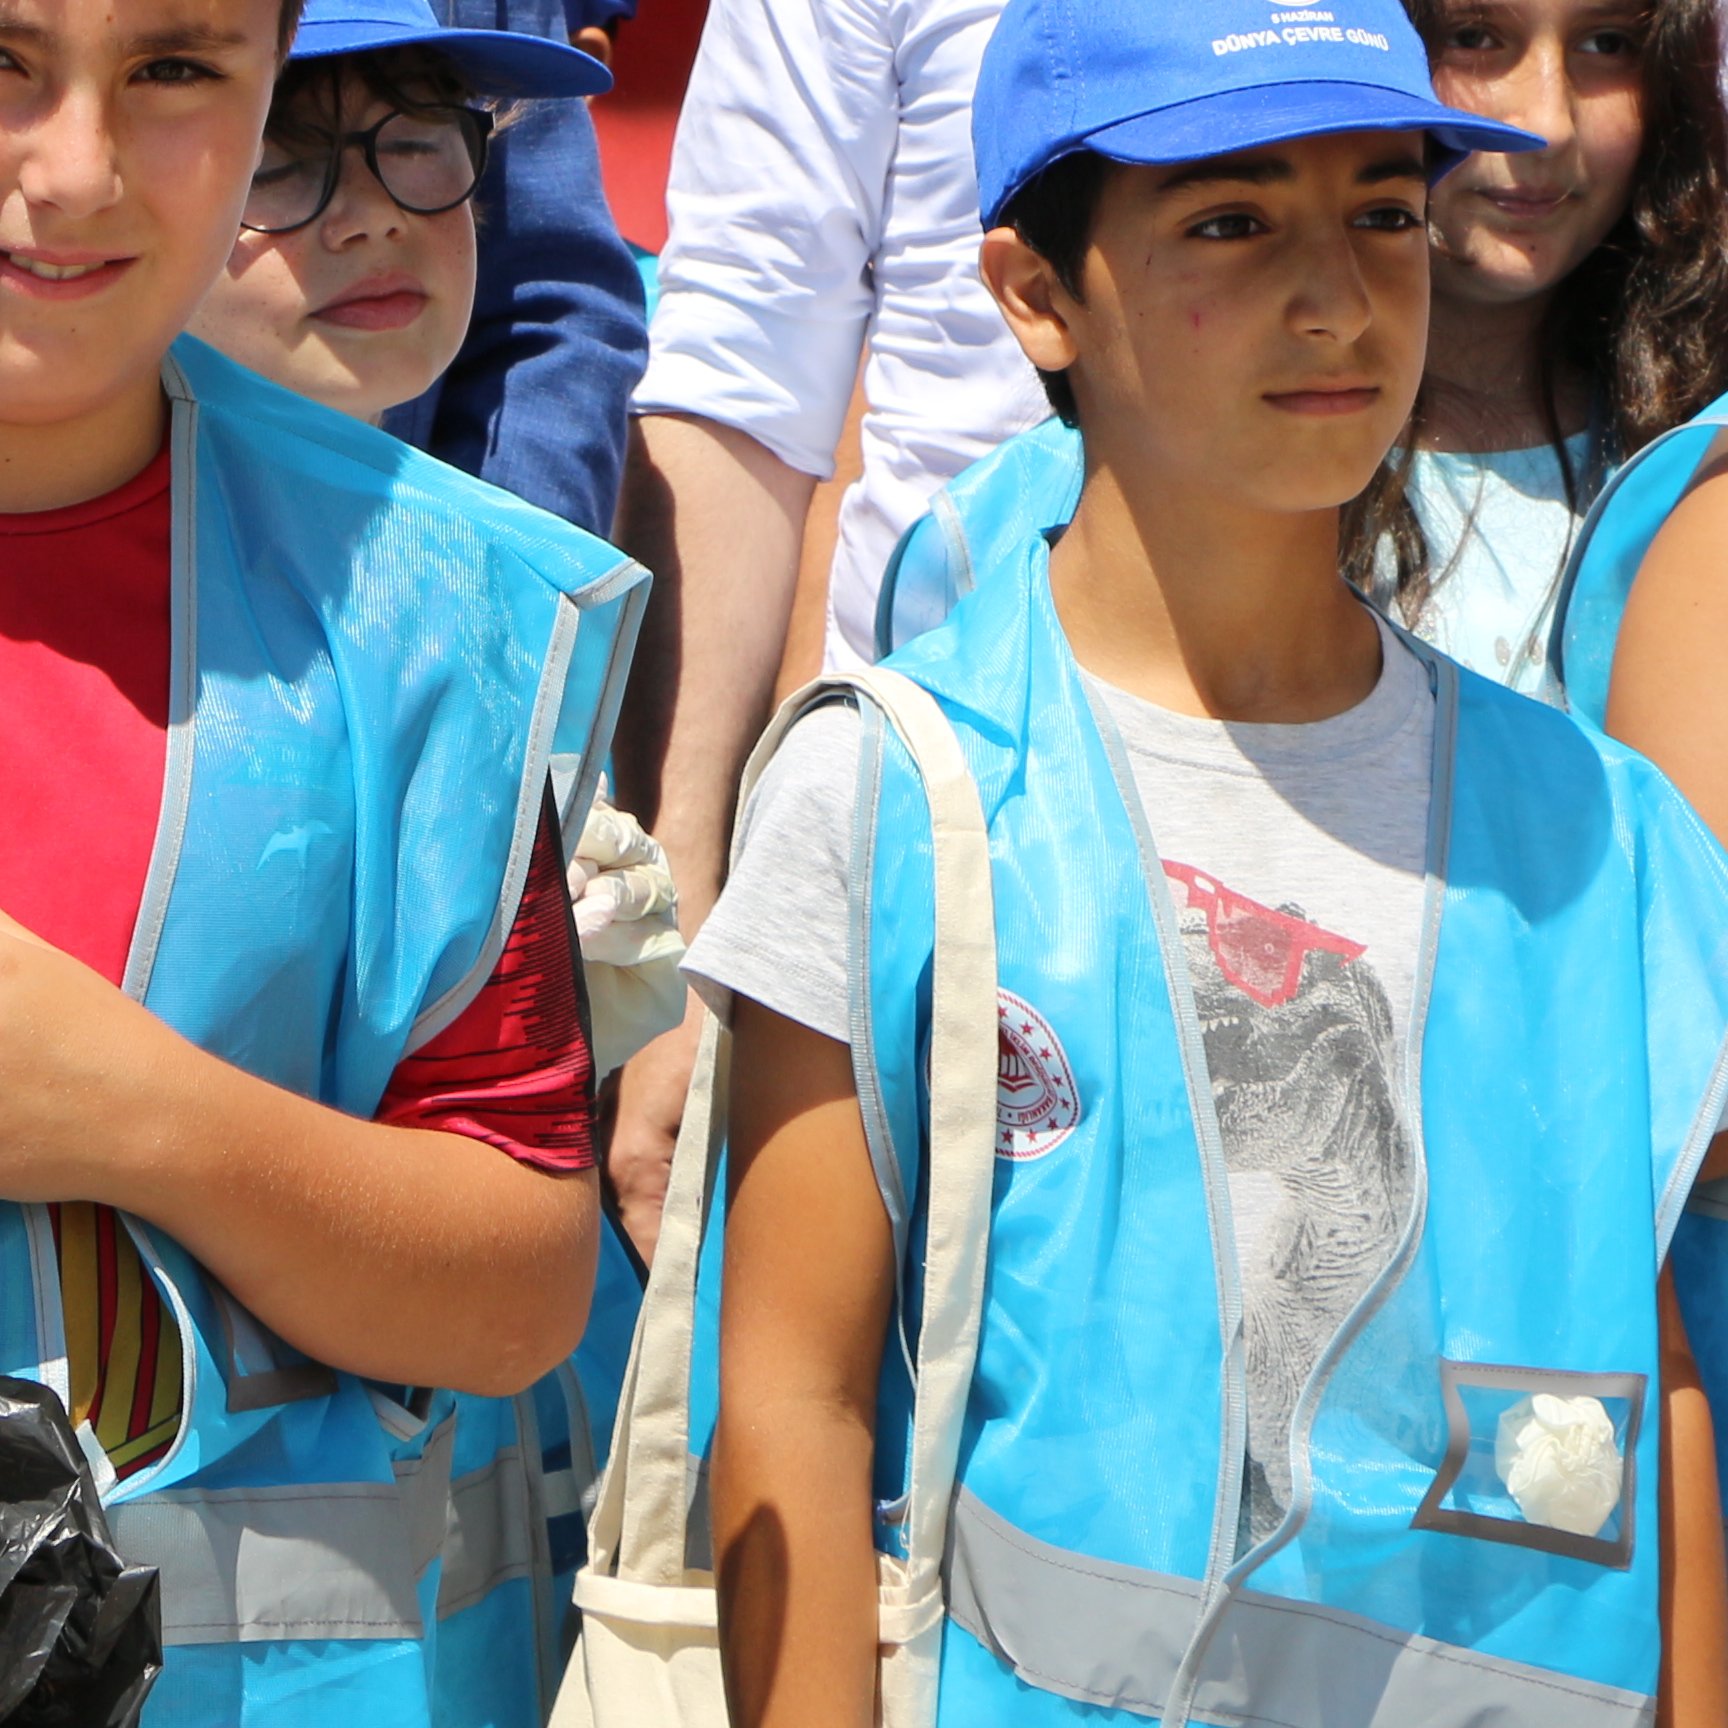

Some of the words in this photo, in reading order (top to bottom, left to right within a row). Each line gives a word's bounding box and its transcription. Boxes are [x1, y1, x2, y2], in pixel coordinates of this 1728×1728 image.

[1282, 9, 1334, 23] HAZİRAN
[1212, 29, 1282, 56] DÜNYA
[1282, 26, 1345, 46] ÇEVRE
[1346, 28, 1390, 52] GÜNÜ
